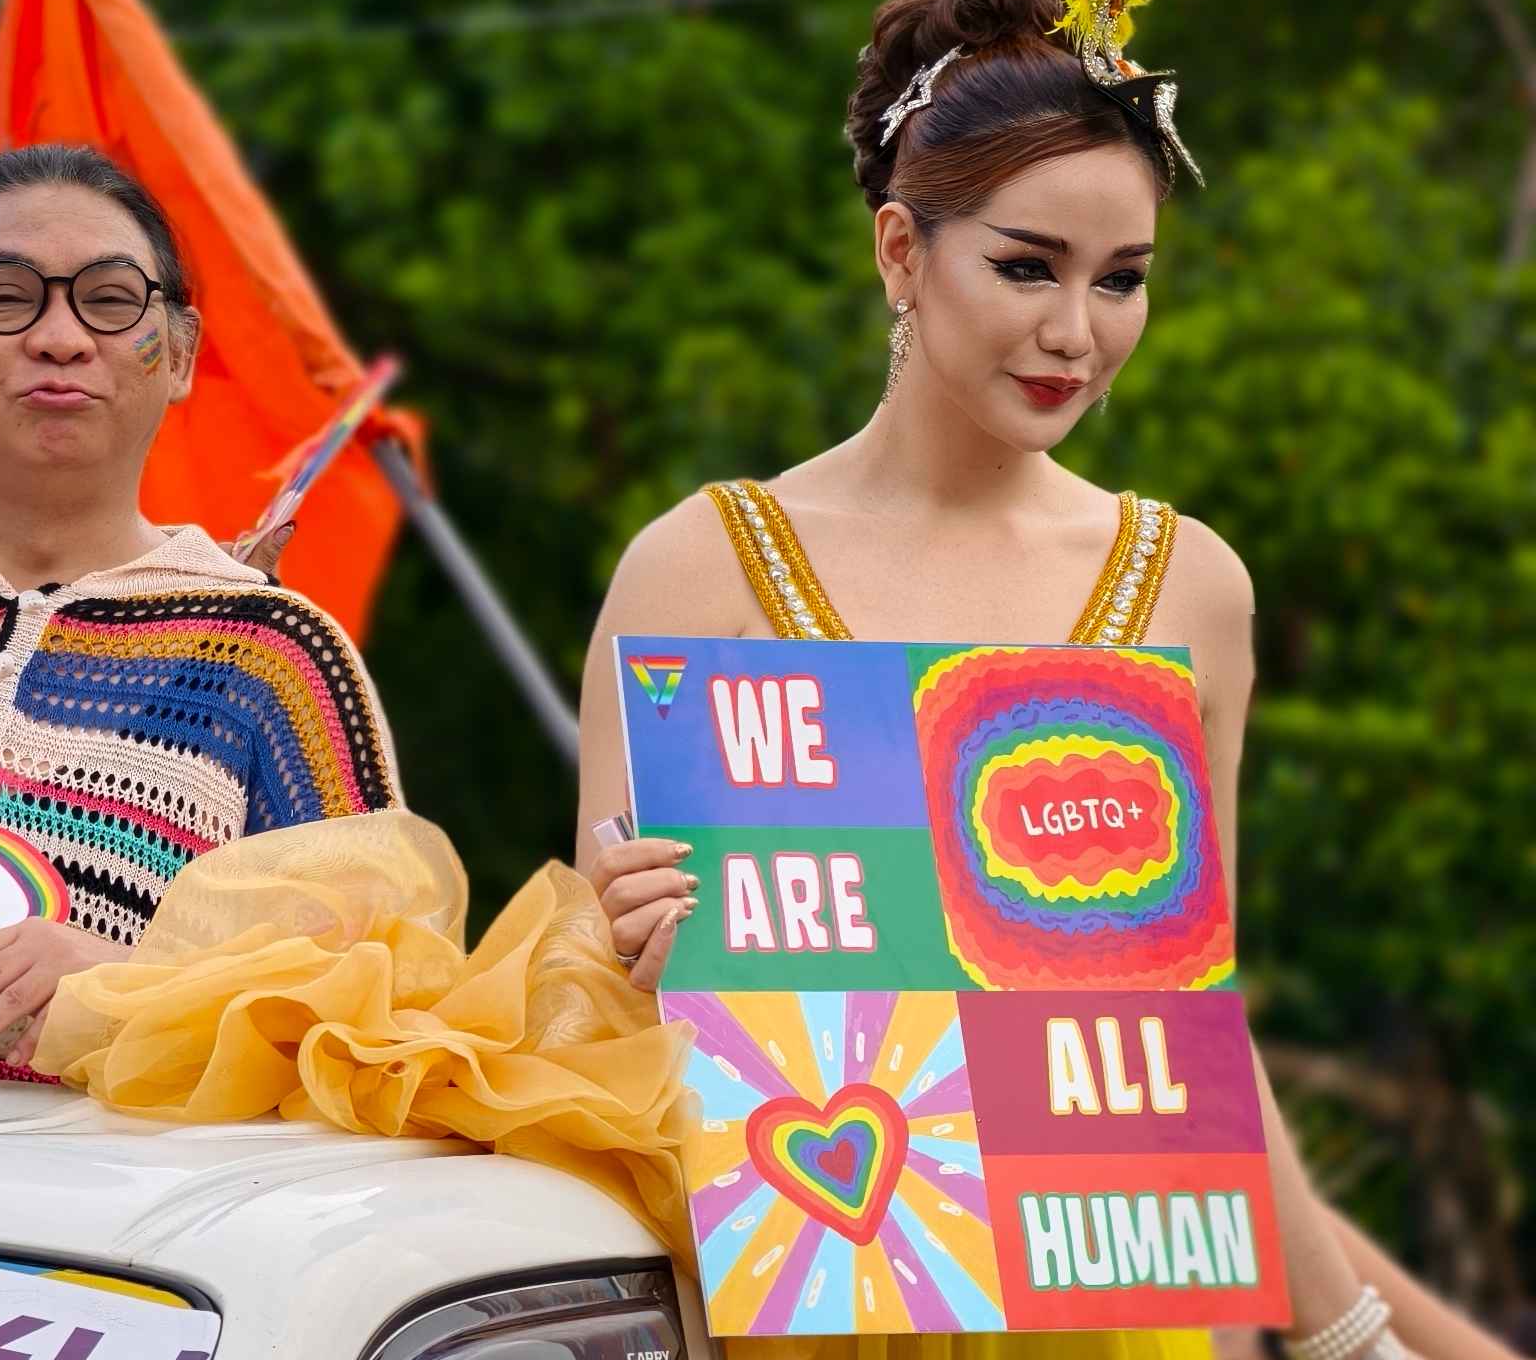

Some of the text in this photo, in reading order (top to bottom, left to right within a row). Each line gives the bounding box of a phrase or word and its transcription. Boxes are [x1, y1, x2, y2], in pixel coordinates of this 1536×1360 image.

[710, 675, 837, 787] WE
[1019, 797, 1144, 837] LGBTQ+
[724, 853, 877, 953] ARE
[1046, 1016, 1188, 1115] ALL
[1019, 1191, 1259, 1291] HUMAN
